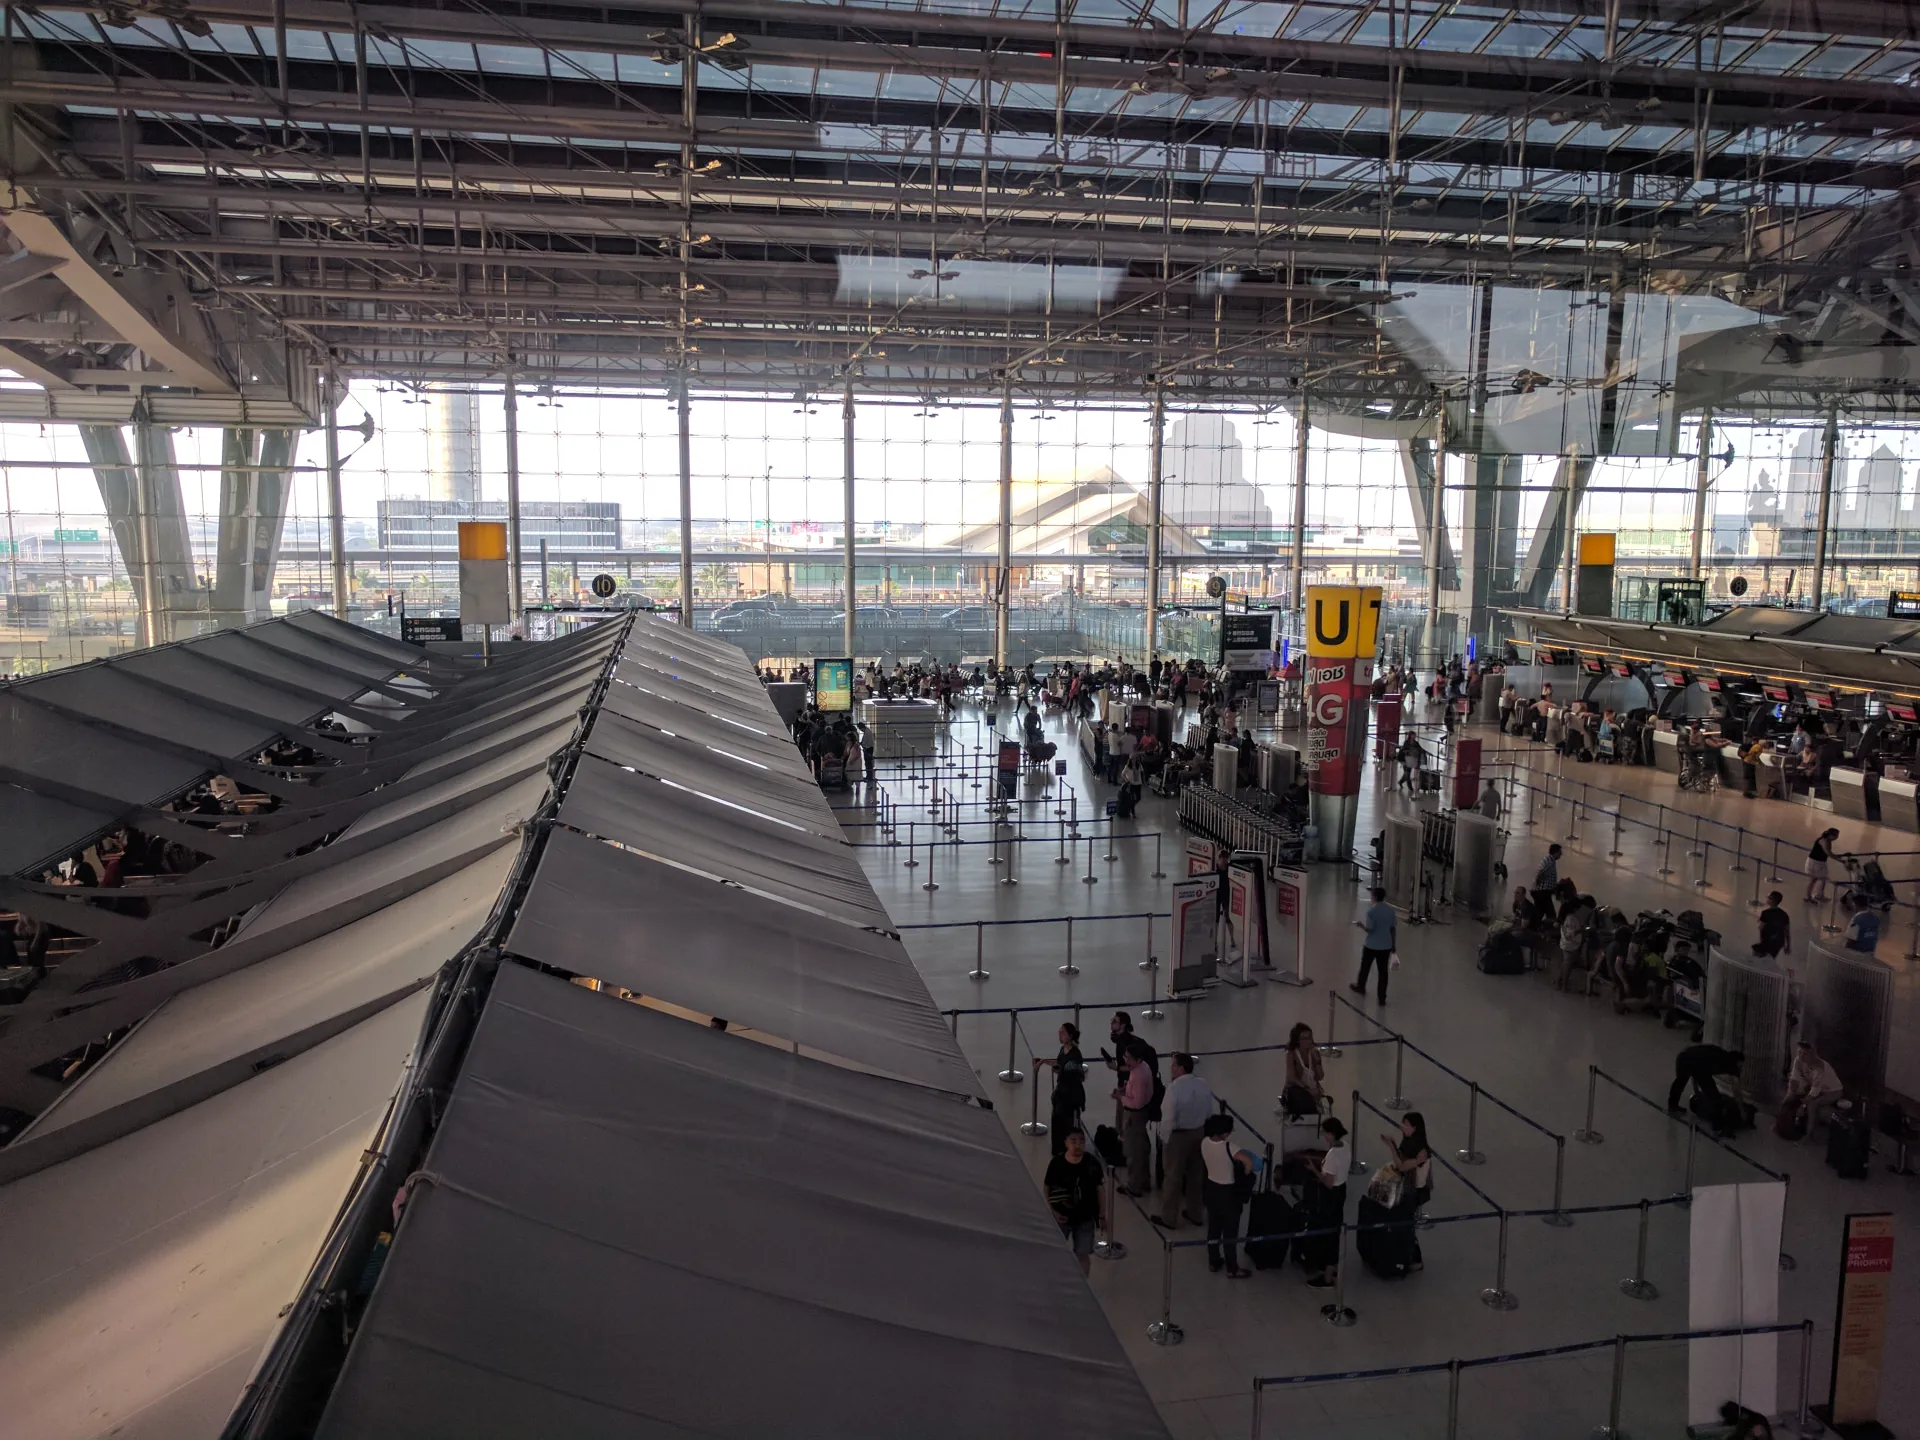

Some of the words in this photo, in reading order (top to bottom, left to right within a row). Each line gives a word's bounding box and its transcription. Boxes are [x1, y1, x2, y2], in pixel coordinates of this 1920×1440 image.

[596, 579, 611, 593] 10
[1212, 581, 1221, 593] 9
[1315, 599, 1350, 646] U
[1848, 1252, 1867, 1260] SKY
[1847, 1258, 1890, 1267] PRIORITY
